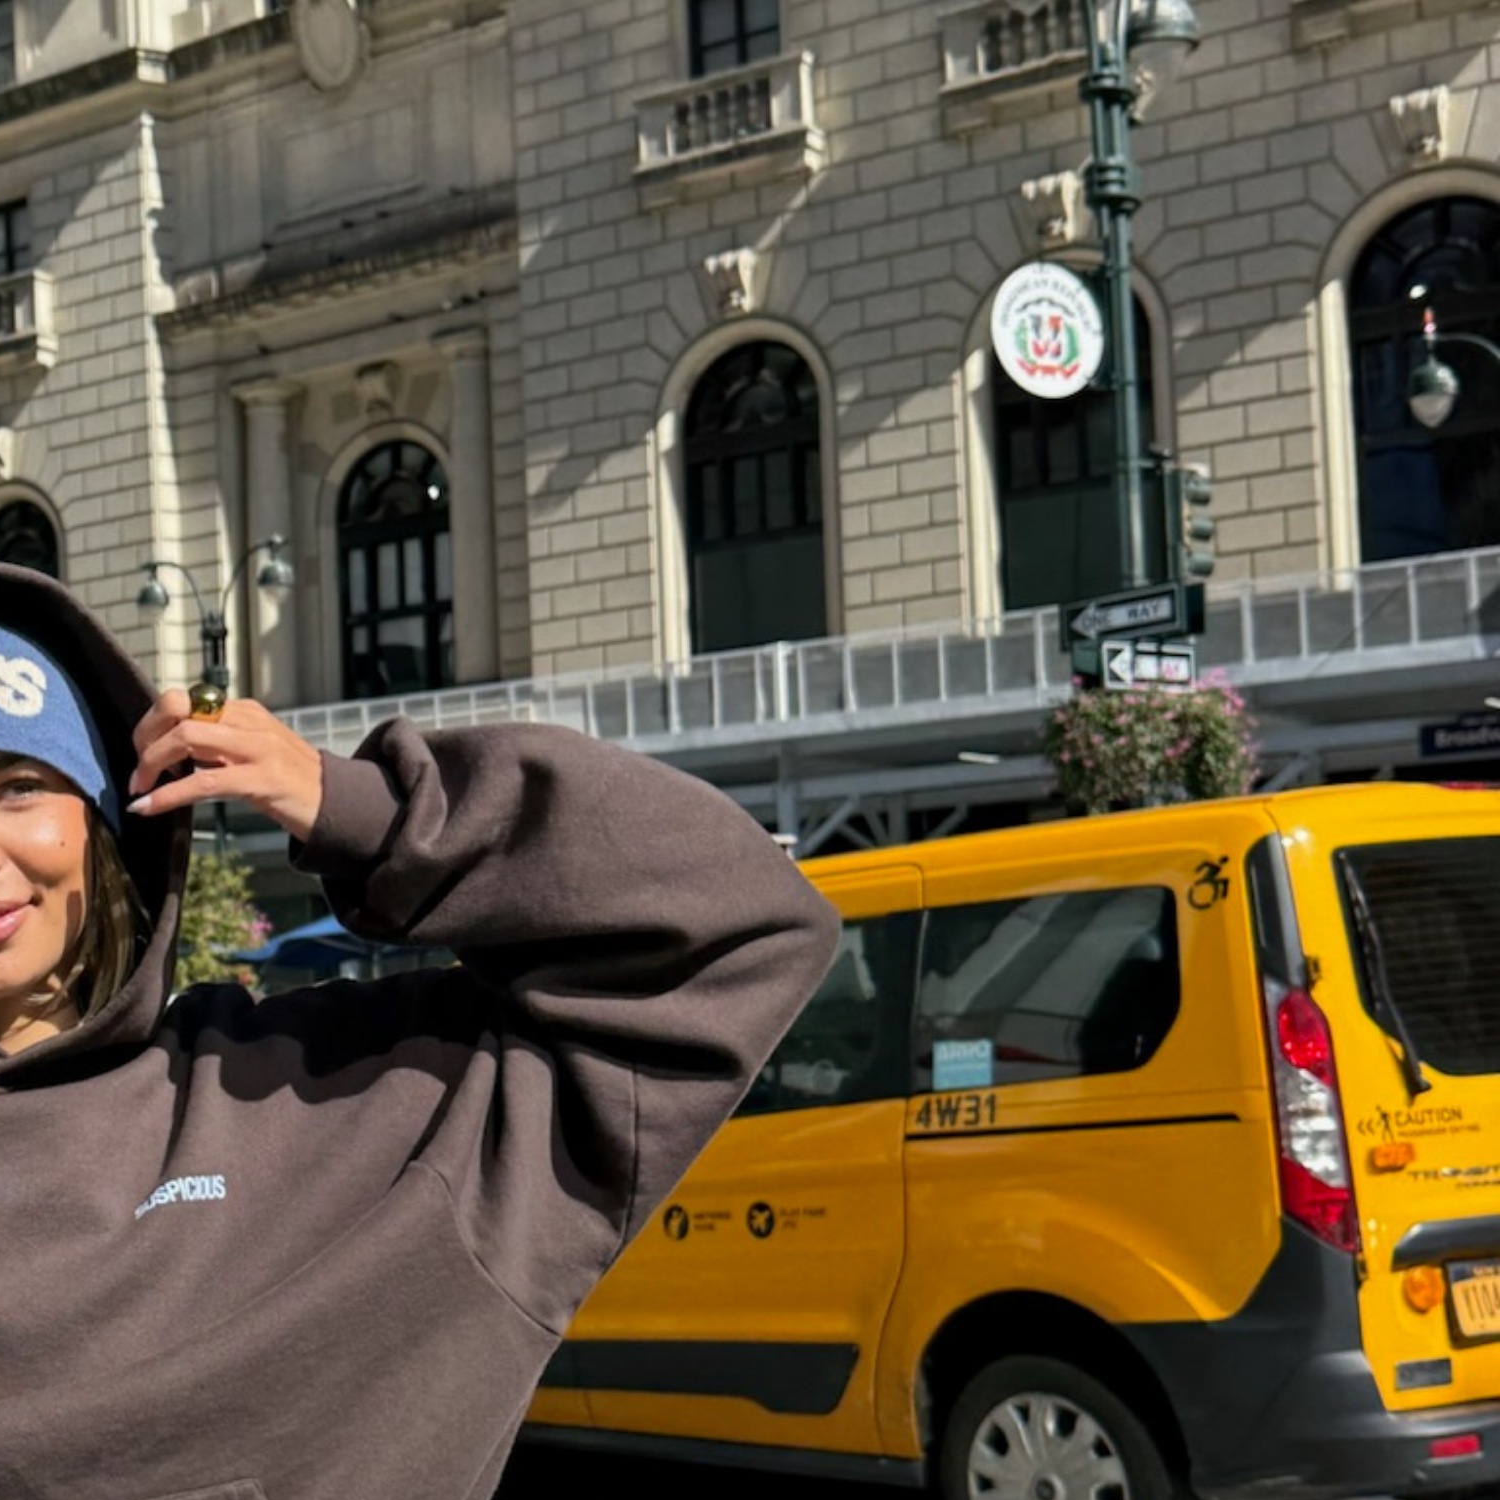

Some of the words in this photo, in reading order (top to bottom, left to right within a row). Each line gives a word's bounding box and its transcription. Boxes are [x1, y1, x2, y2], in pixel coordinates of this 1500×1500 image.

[1127, 603, 1160, 620] WAY
[915, 1093, 997, 1129] 4W31
[1395, 1108, 1463, 1127] CAUTION
